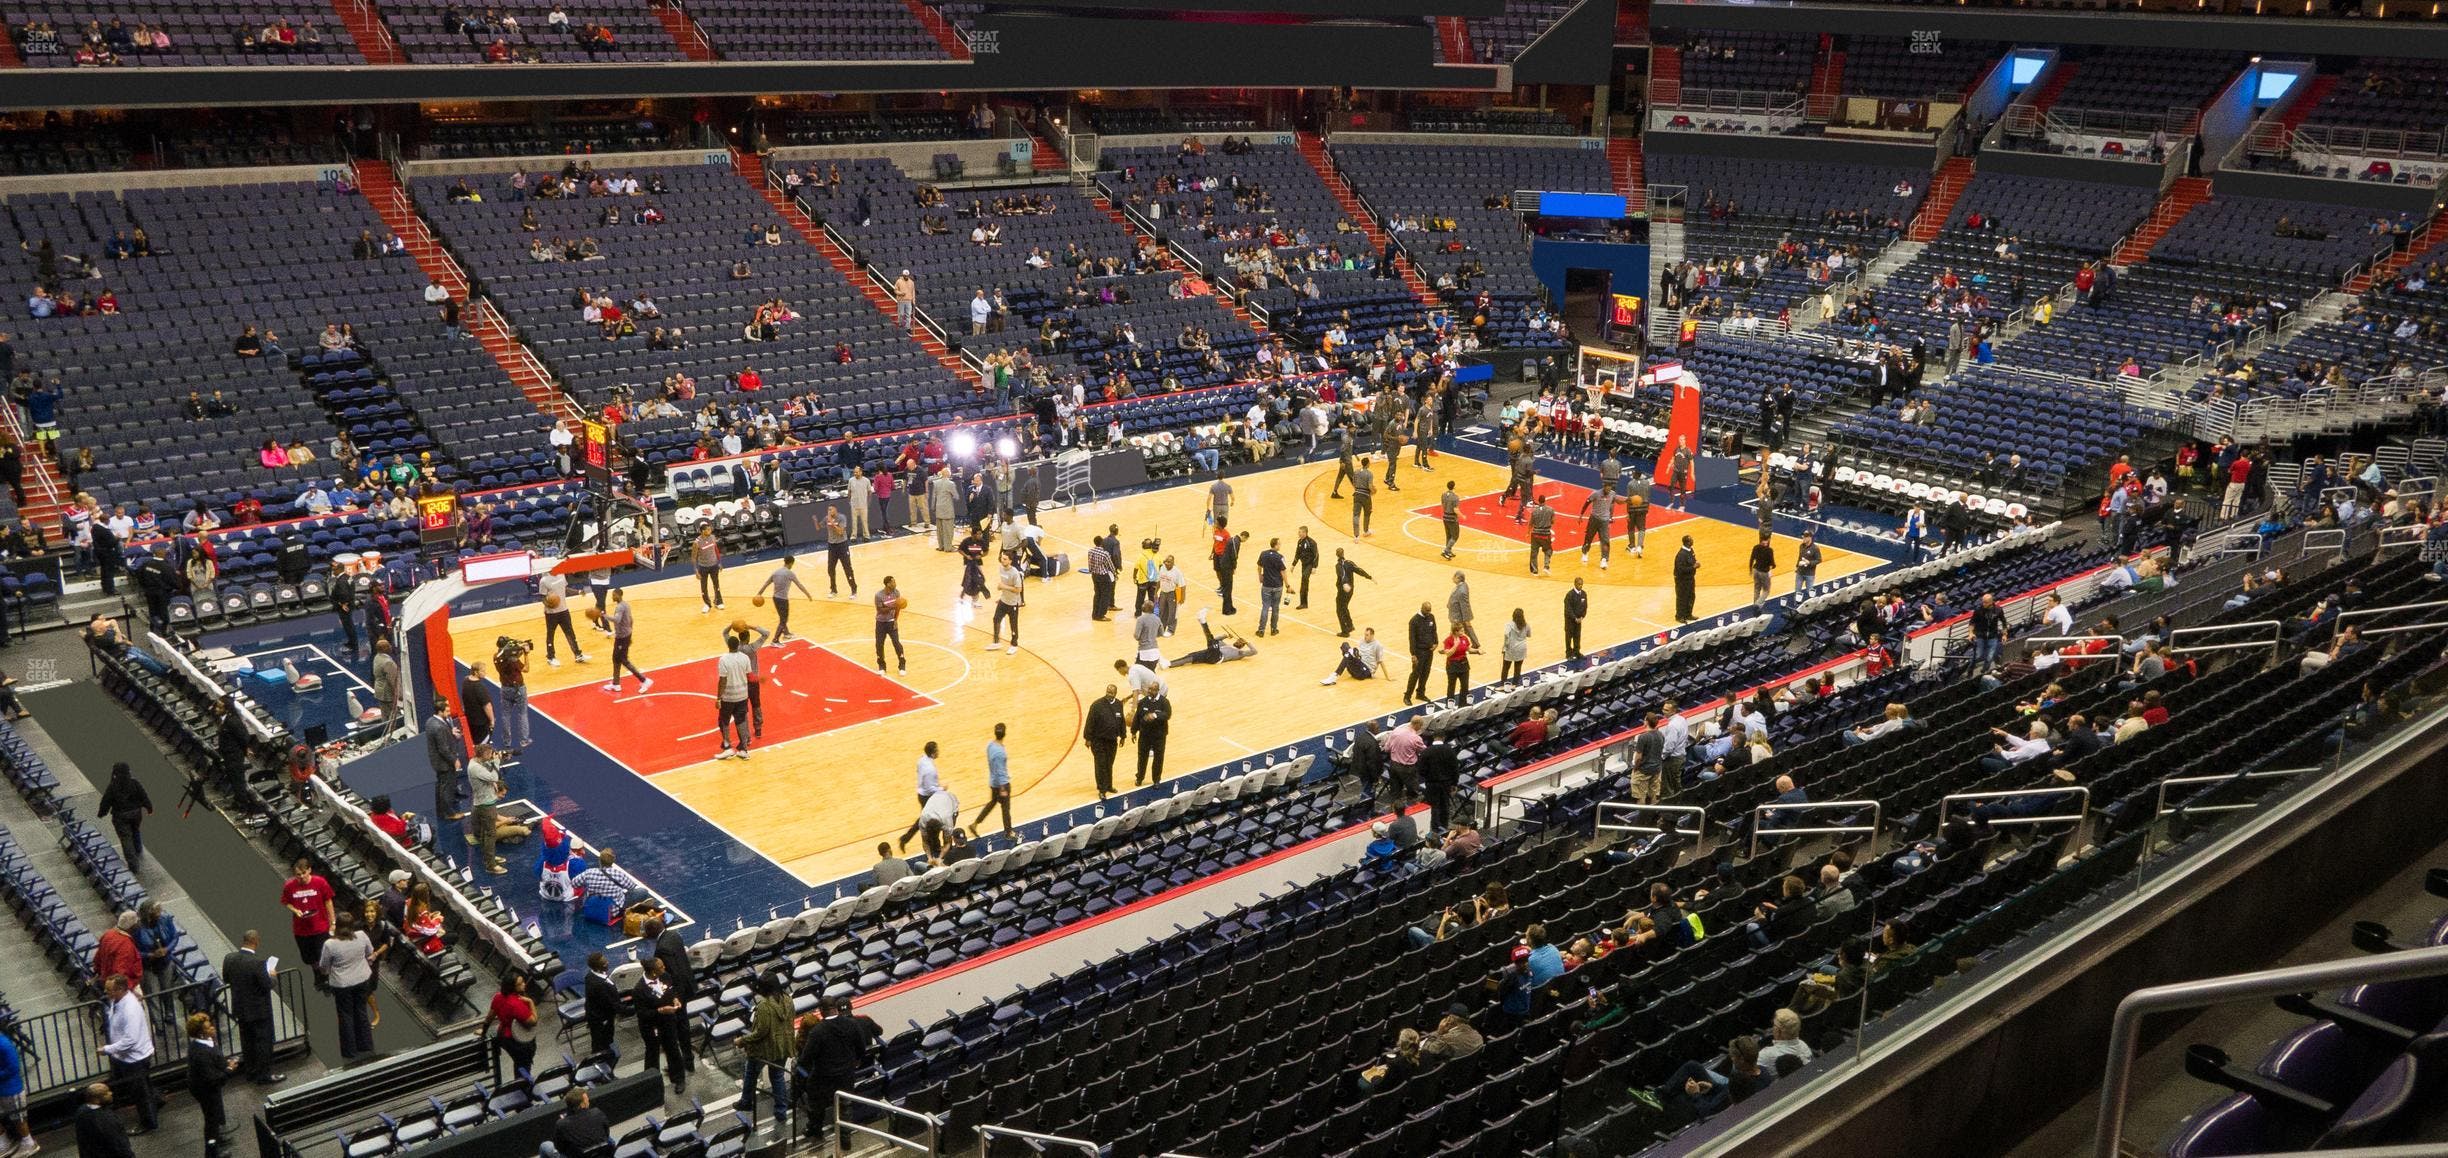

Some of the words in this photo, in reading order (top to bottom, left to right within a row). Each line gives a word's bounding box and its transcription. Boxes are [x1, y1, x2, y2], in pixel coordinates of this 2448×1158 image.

[1276, 135, 1291, 145] 120
[1015, 142, 1028, 153] 121
[1585, 141, 1600, 151] 119
[706, 154, 728, 165] 100
[323, 169, 344, 182] 10
